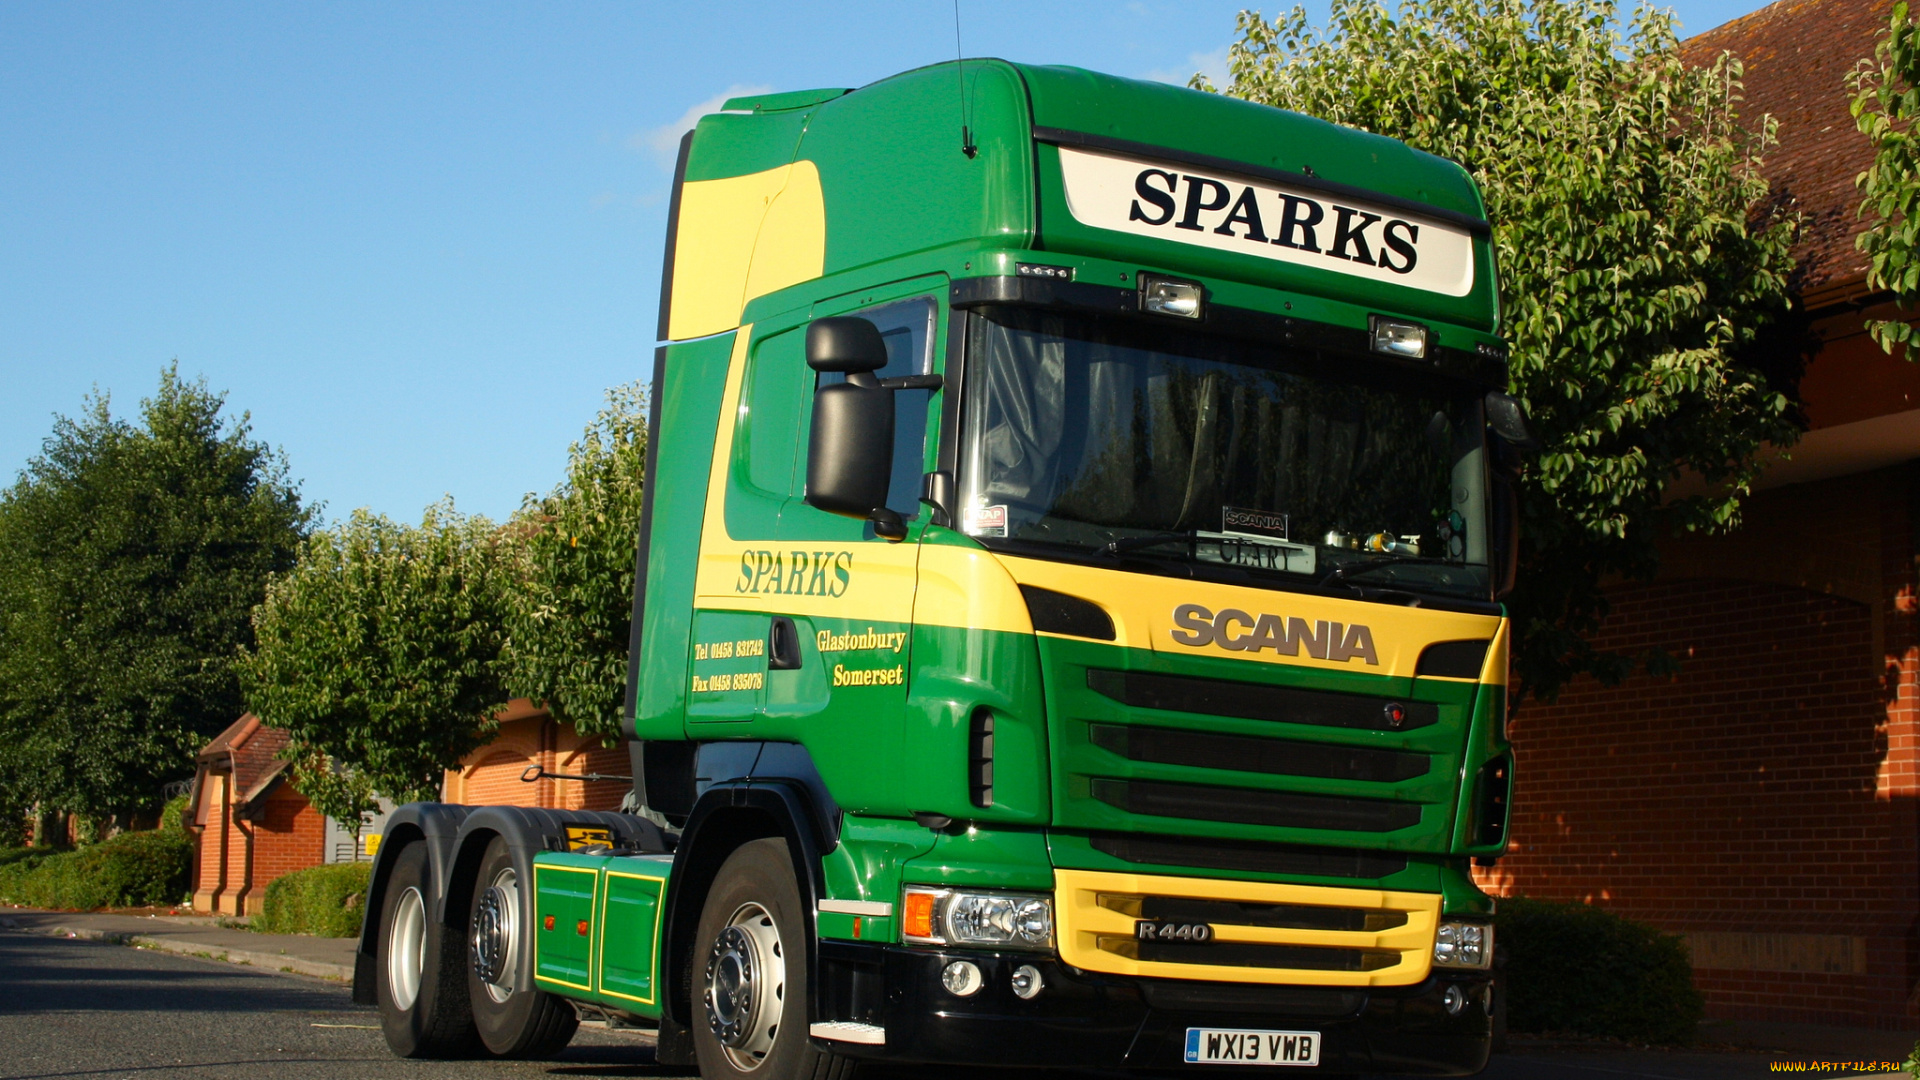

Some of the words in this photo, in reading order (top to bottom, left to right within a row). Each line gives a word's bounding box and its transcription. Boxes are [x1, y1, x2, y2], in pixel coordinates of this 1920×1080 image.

[1128, 168, 1420, 274] SPARKS
[1225, 511, 1285, 531] SCANIA
[735, 549, 854, 598] SPARKS
[817, 626, 906, 653] Glastonbury
[1170, 603, 1379, 666] SCANIA
[694, 642, 708, 660] Tel
[711, 641, 733, 659] 01458
[736, 638, 764, 657] 831742
[692, 675, 708, 692] Fax
[709, 673, 731, 691] 01458
[733, 672, 762, 690] 835078
[833, 663, 903, 687] Somerset
[1206, 1033, 1260, 1060] WX13
[1268, 1034, 1313, 1061] VWB
